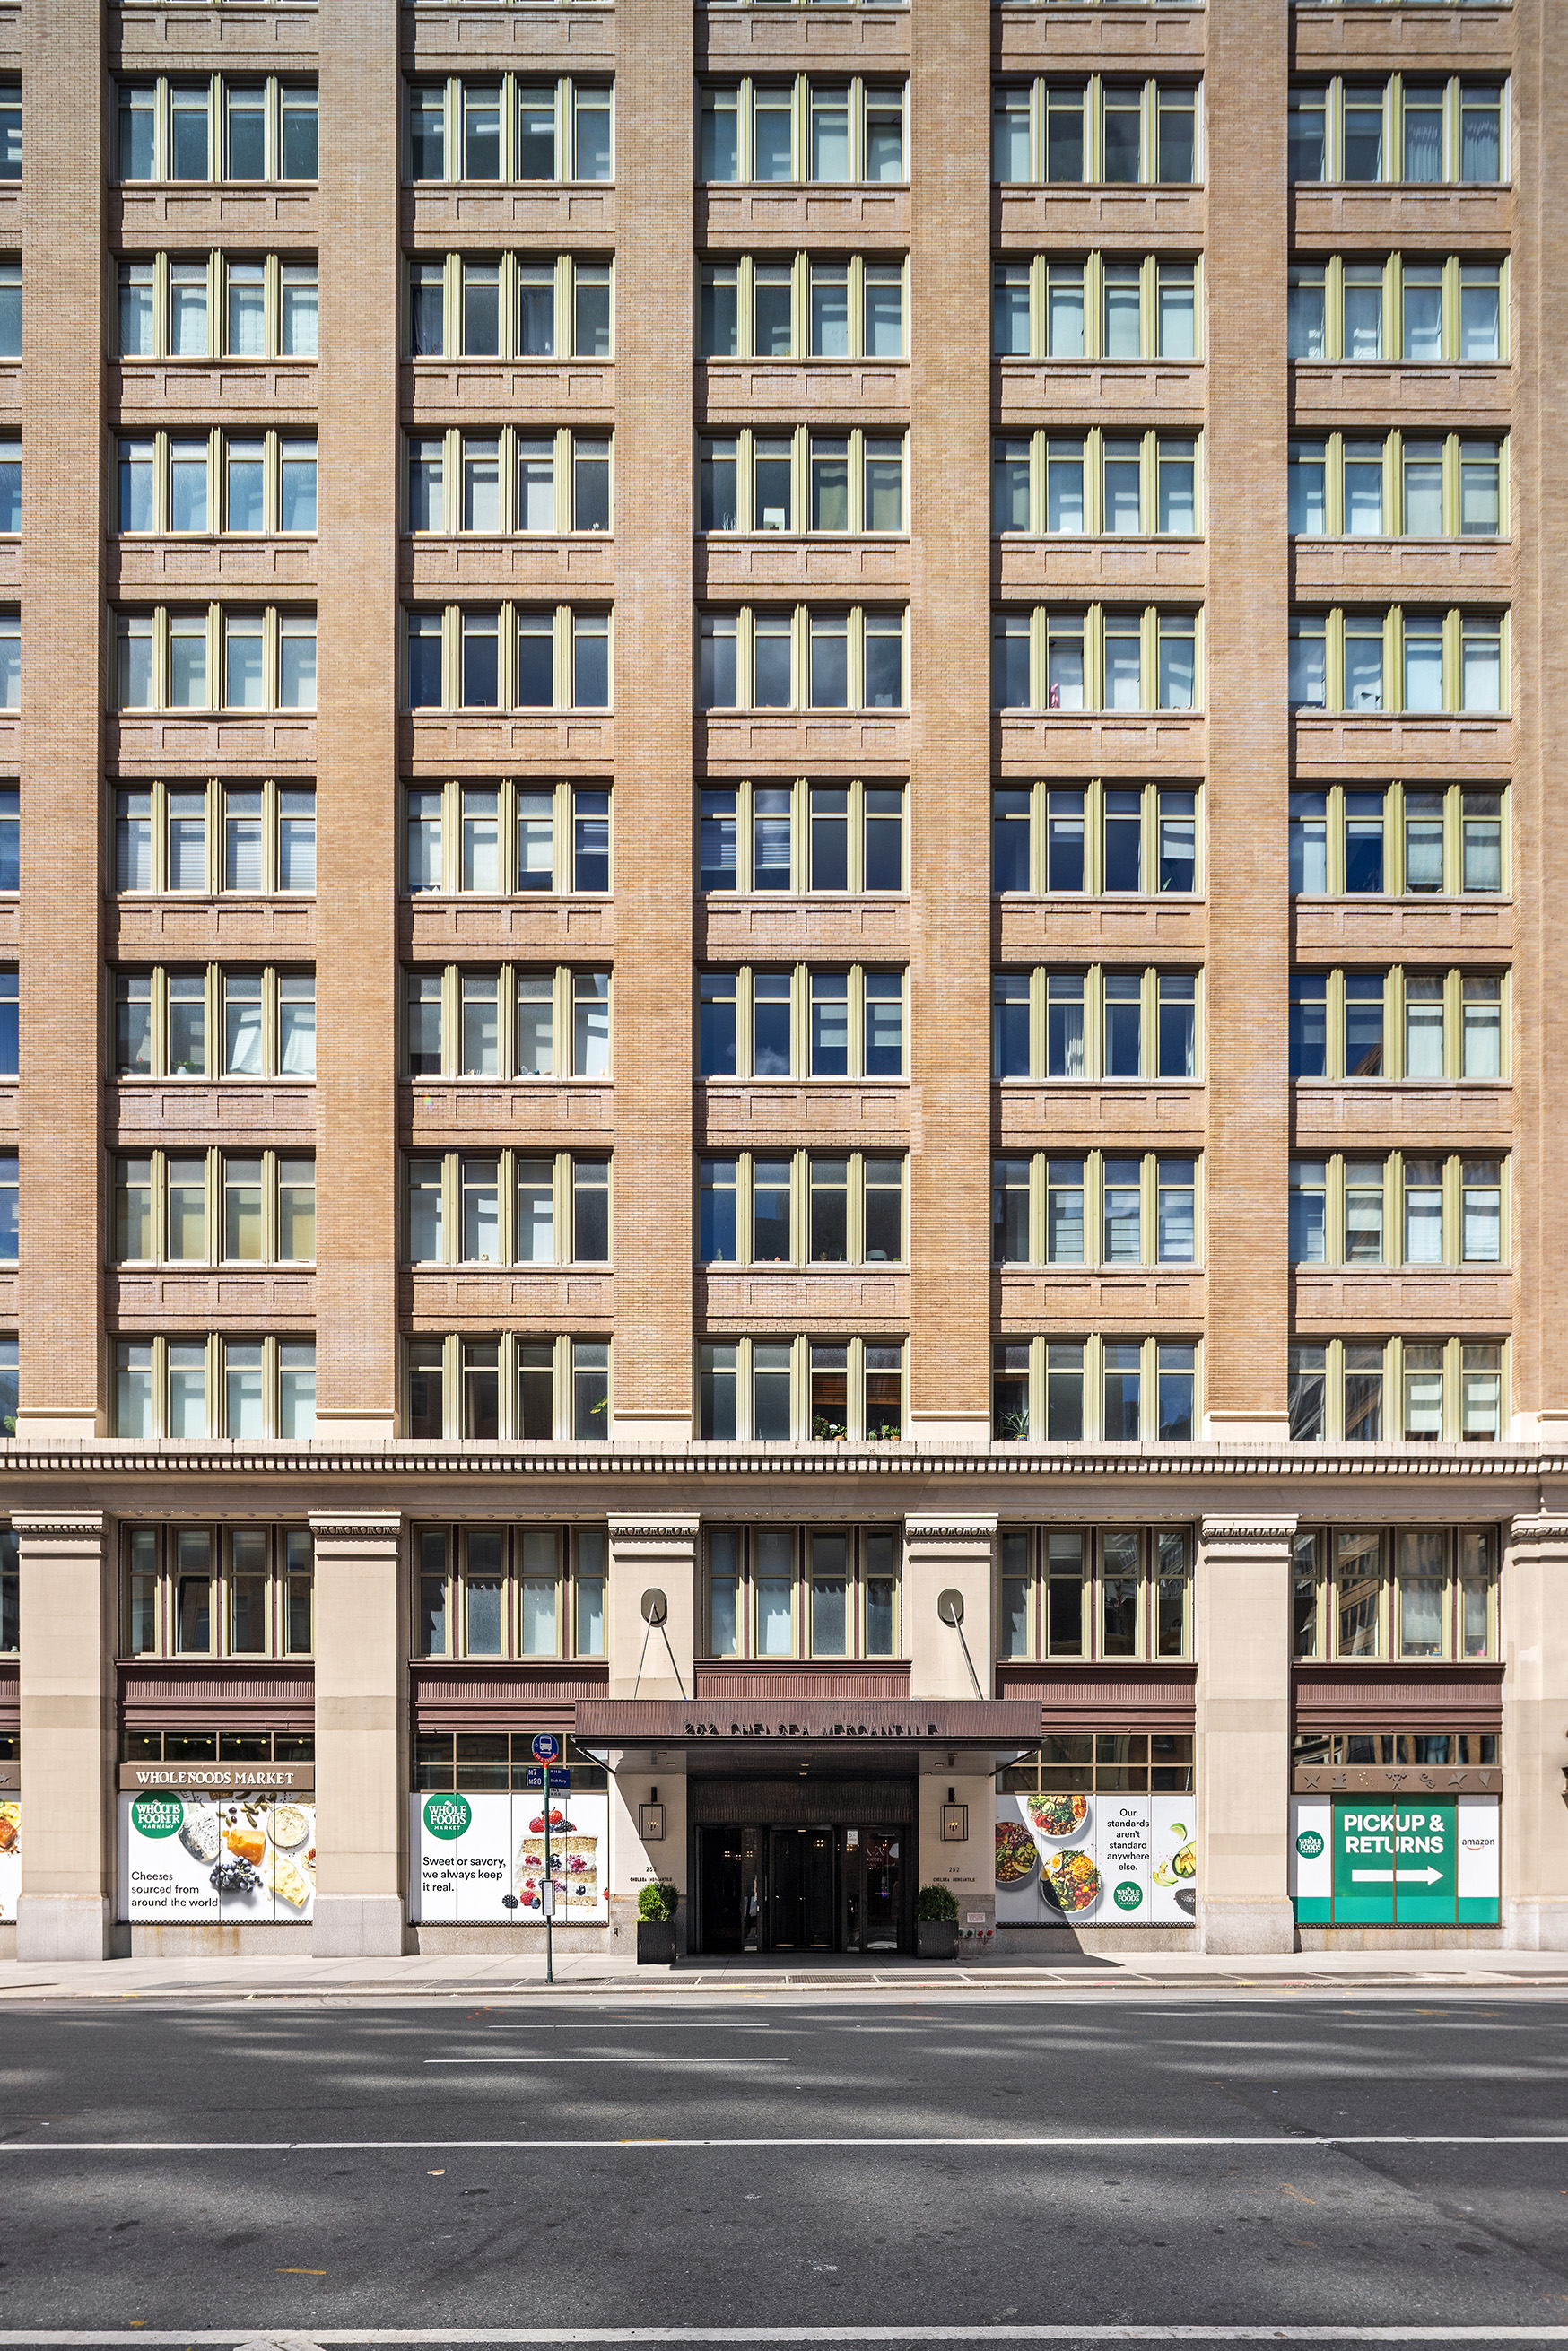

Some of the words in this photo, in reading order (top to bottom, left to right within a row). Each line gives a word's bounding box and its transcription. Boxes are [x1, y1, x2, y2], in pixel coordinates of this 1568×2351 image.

[135, 1772, 187, 1784] WHOLE
[234, 1772, 295, 1785] MARKET
[428, 1804, 467, 1815] WHOLE
[1119, 1808, 1137, 1816] Our
[430, 1815, 466, 1824] FOODS
[1107, 1819, 1150, 1828] standards
[1344, 1814, 1425, 1832] PICKUP
[1429, 1814, 1445, 1832] &
[1116, 1830, 1141, 1839] aren't
[1109, 1841, 1147, 1850] standard
[1346, 1836, 1444, 1853] RETURNS
[1461, 1838, 1495, 1846] amazon
[1107, 1851, 1150, 1862] anywhere
[422, 1856, 455, 1866] Sweet
[470, 1859, 506, 1868] savory,
[1118, 1862, 1138, 1871] else.
[131, 1871, 173, 1881] Cheeses
[422, 1871, 439, 1879] we
[440, 1869, 476, 1881] always
[478, 1869, 503, 1881] keep
[131, 1885, 171, 1894] sourced
[175, 1885, 199, 1894] from
[422, 1882, 430, 1892] it
[432, 1882, 455, 1892] real.
[131, 1897, 168, 1907] around
[170, 1897, 187, 1907] the
[188, 1897, 218, 1907] world
